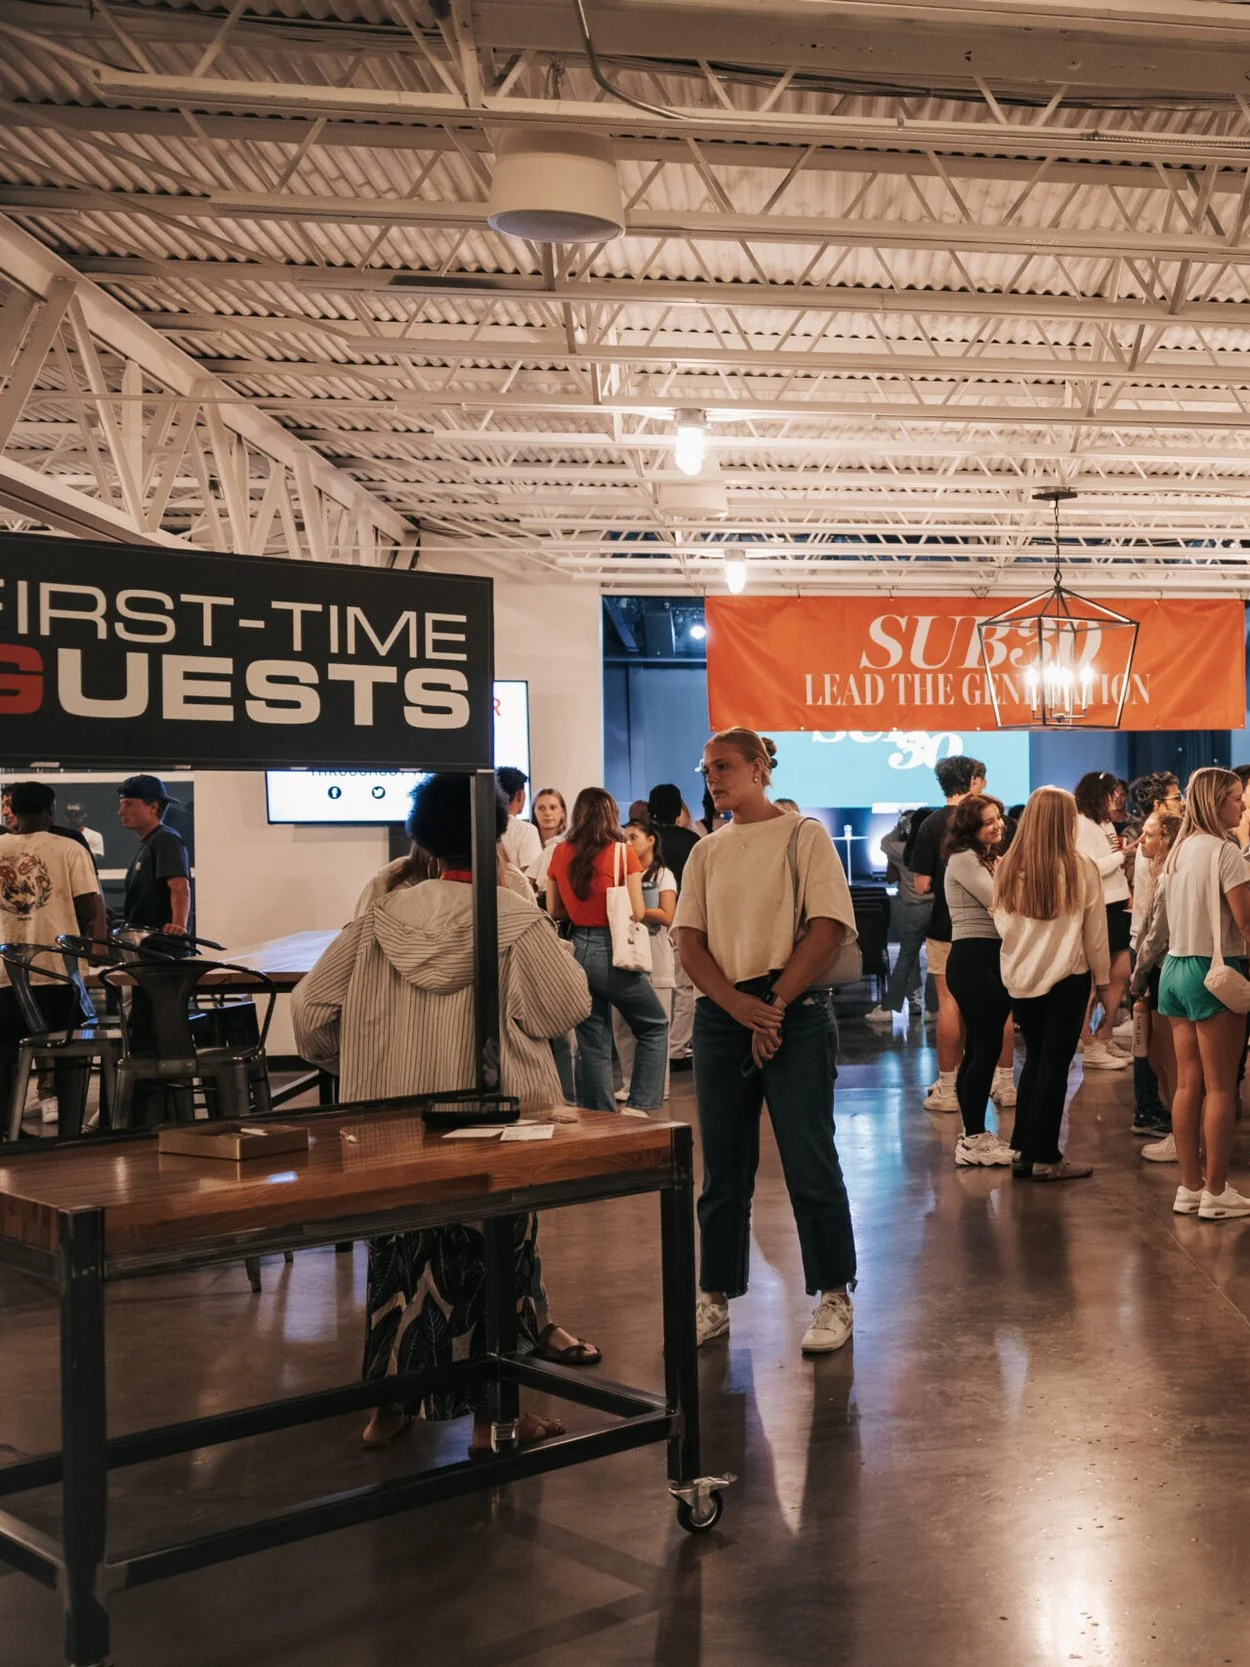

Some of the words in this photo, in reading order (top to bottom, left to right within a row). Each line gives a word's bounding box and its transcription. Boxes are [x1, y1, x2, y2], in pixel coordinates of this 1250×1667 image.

[0, 578, 467, 661] IRST-TIME
[859, 614, 1102, 670] SUB30
[804, 673, 885, 706] LEAD
[891, 673, 954, 706] THE
[961, 672, 1152, 707] GENETION
